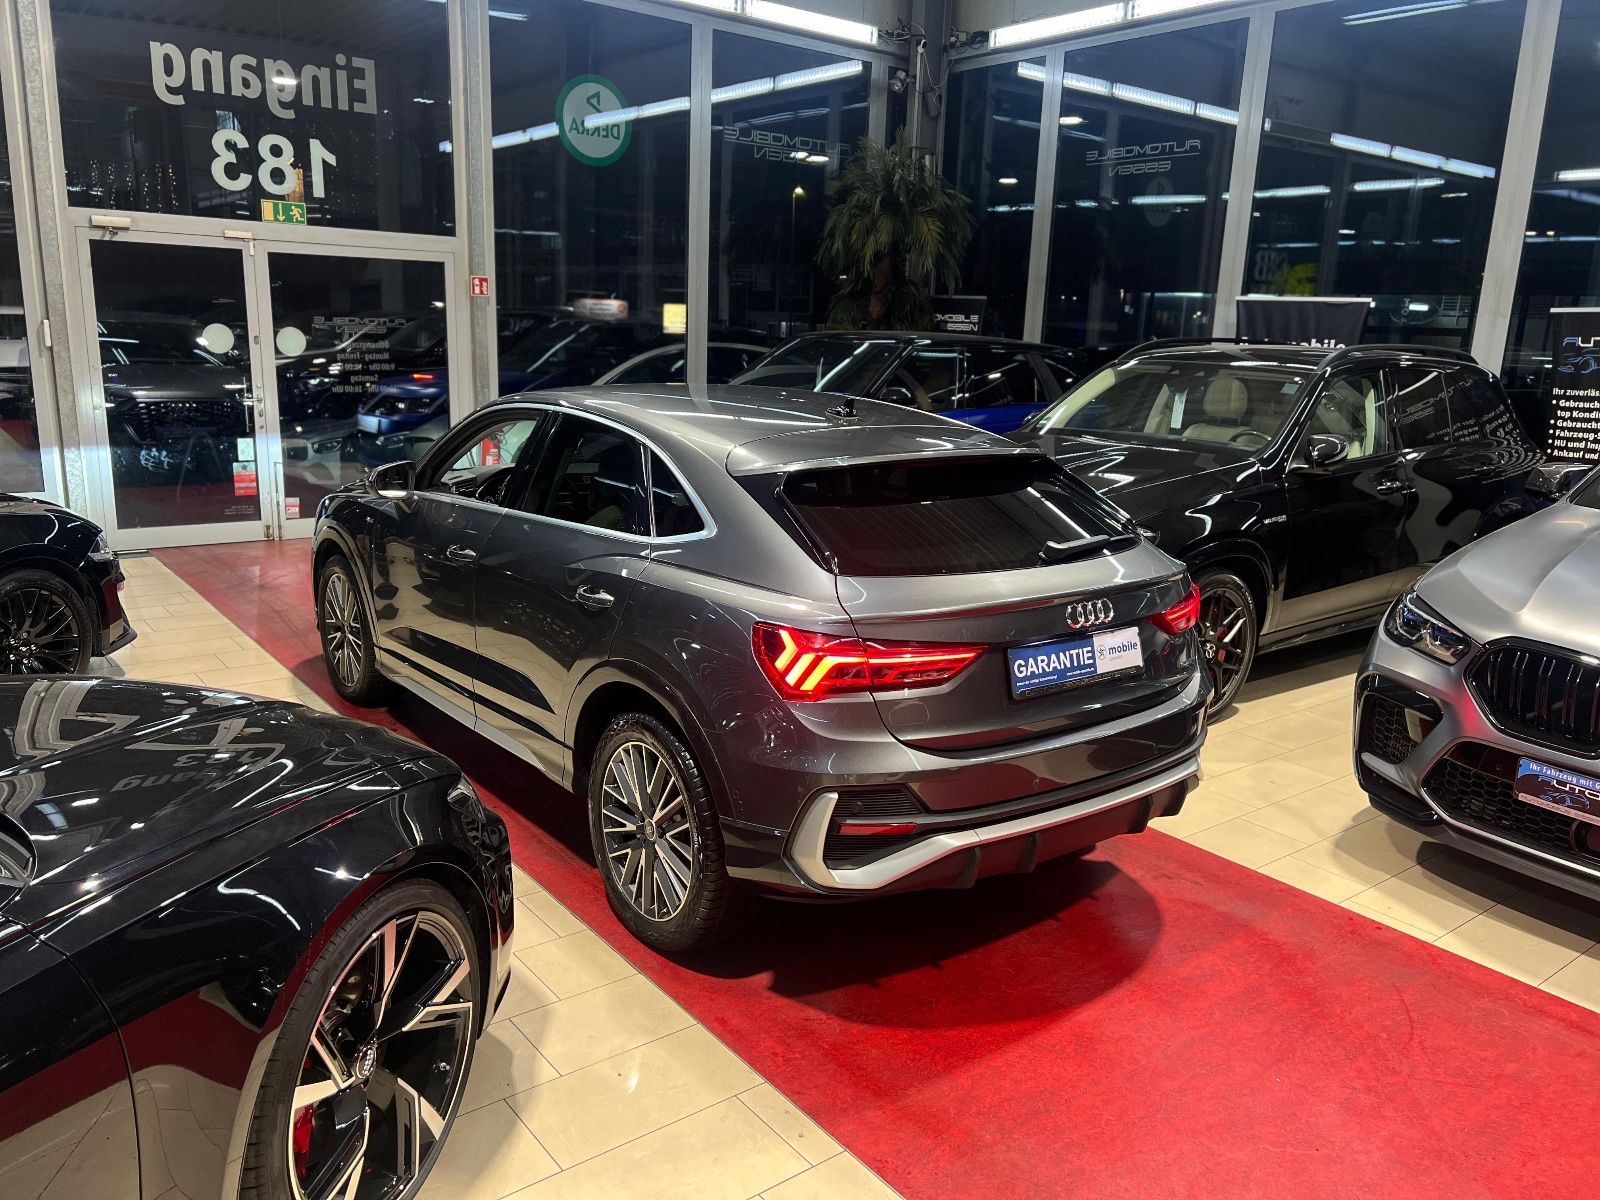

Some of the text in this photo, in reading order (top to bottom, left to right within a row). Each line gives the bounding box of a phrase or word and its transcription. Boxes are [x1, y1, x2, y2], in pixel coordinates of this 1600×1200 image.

[1552, 387, 1565, 395] Ihr
[1559, 399, 1600, 408] Gebrauch
[1557, 410, 1571, 418] top
[1554, 439, 1566, 447] HU
[1567, 440, 1586, 448] und
[1552, 449, 1599, 460] Ankauf und
[1014, 646, 1094, 678] GARANTIE
[1108, 640, 1138, 655] mobile
[1529, 762, 1541, 771] Ihr
[1542, 766, 1577, 784] Fahrzeug
[1579, 778, 1593, 787] mit
